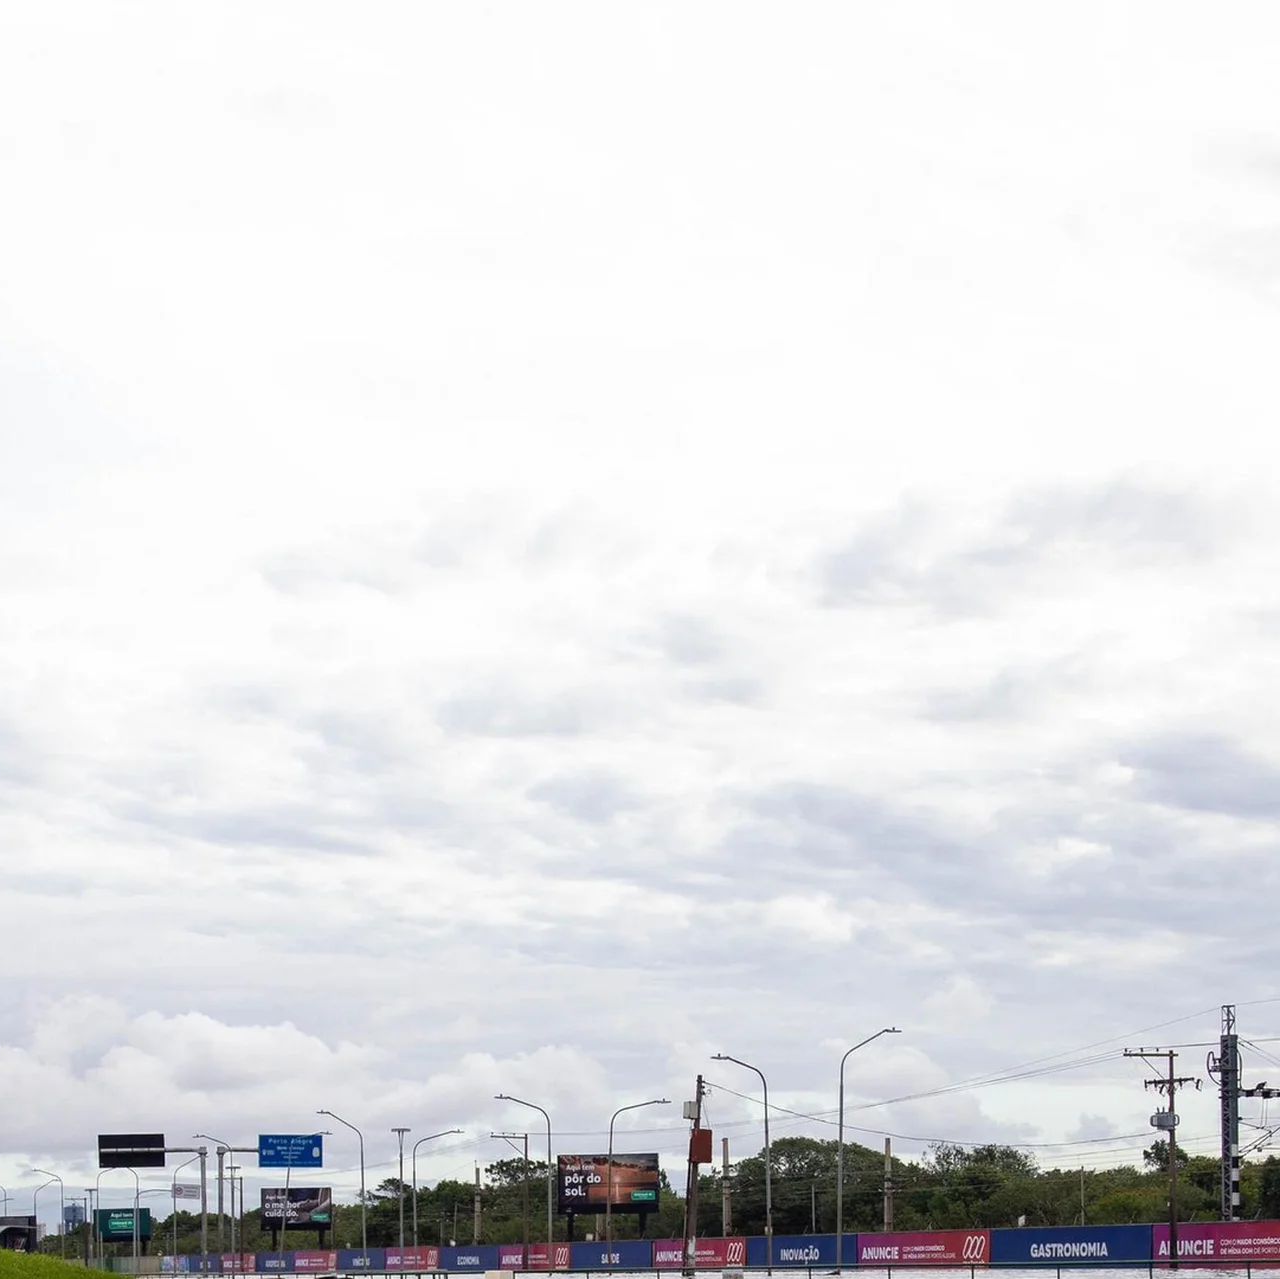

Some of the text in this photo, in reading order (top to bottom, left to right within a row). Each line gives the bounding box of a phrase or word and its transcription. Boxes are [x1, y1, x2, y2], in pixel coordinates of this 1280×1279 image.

[565, 1173, 601, 1186] pôr do
[565, 1185, 586, 1196] sol.
[271, 1201, 301, 1209] mehor
[780, 1245, 820, 1265] INOVAÇÃO
[862, 1246, 899, 1260] ANUNCIE
[1030, 1242, 1109, 1258] GASTRONOMIA
[457, 1255, 480, 1266] ECONOMIA
[601, 1253, 620, 1264] SADE
[656, 1251, 683, 1262] ANUNCIE
